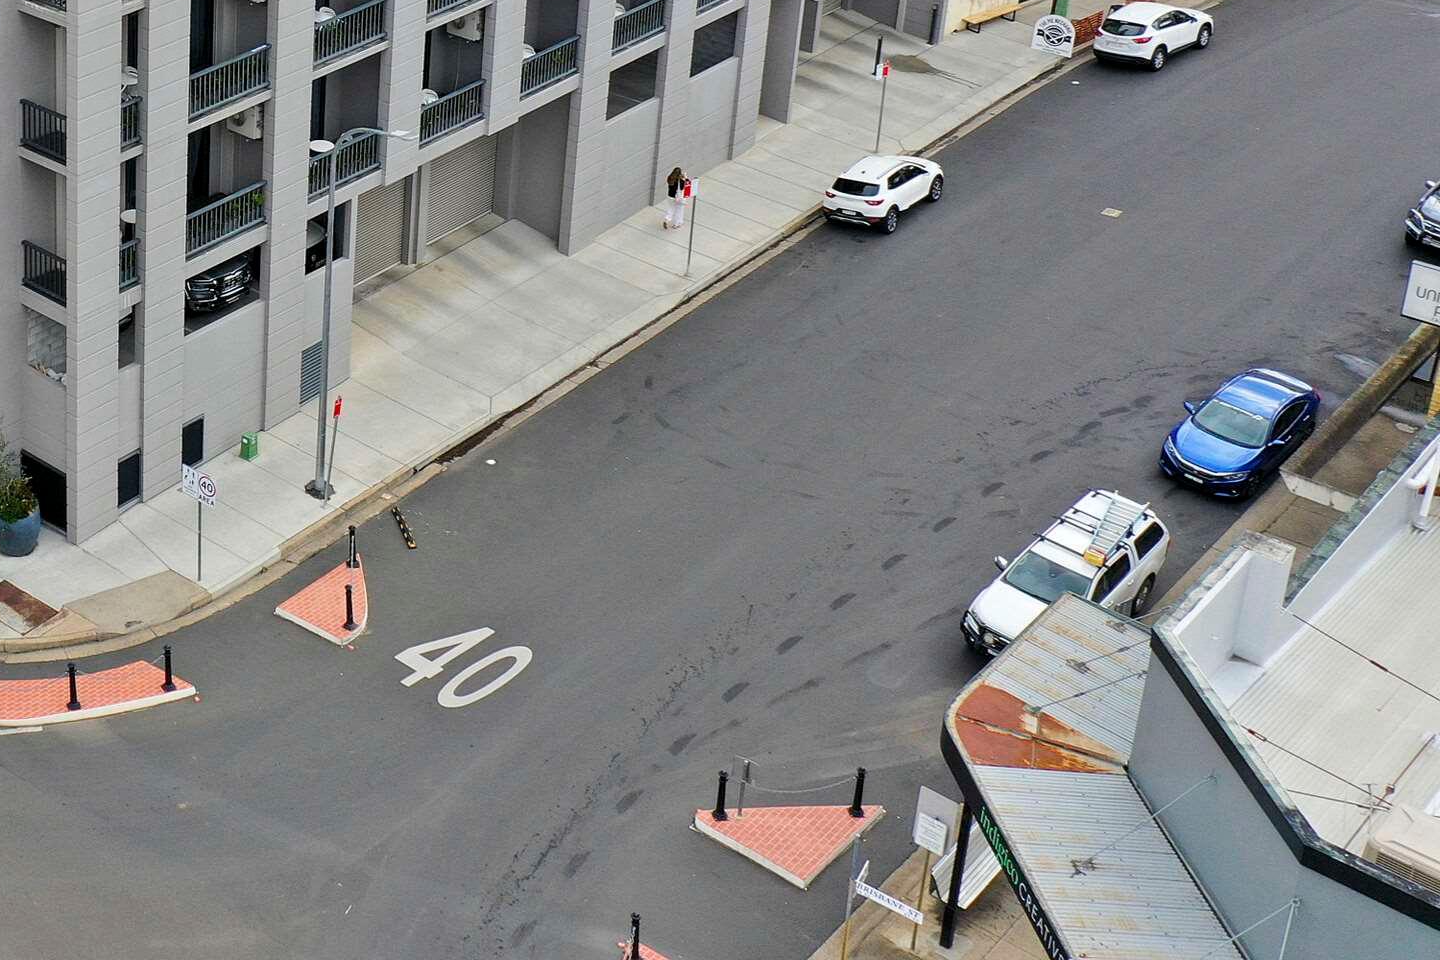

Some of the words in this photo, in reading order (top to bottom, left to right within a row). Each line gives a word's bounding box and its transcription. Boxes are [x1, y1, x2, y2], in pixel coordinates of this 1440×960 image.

[200, 481, 213, 493] 40
[394, 626, 533, 708] 40
[980, 806, 1020, 885] indigico
[856, 882, 903, 910] BRISBANE
